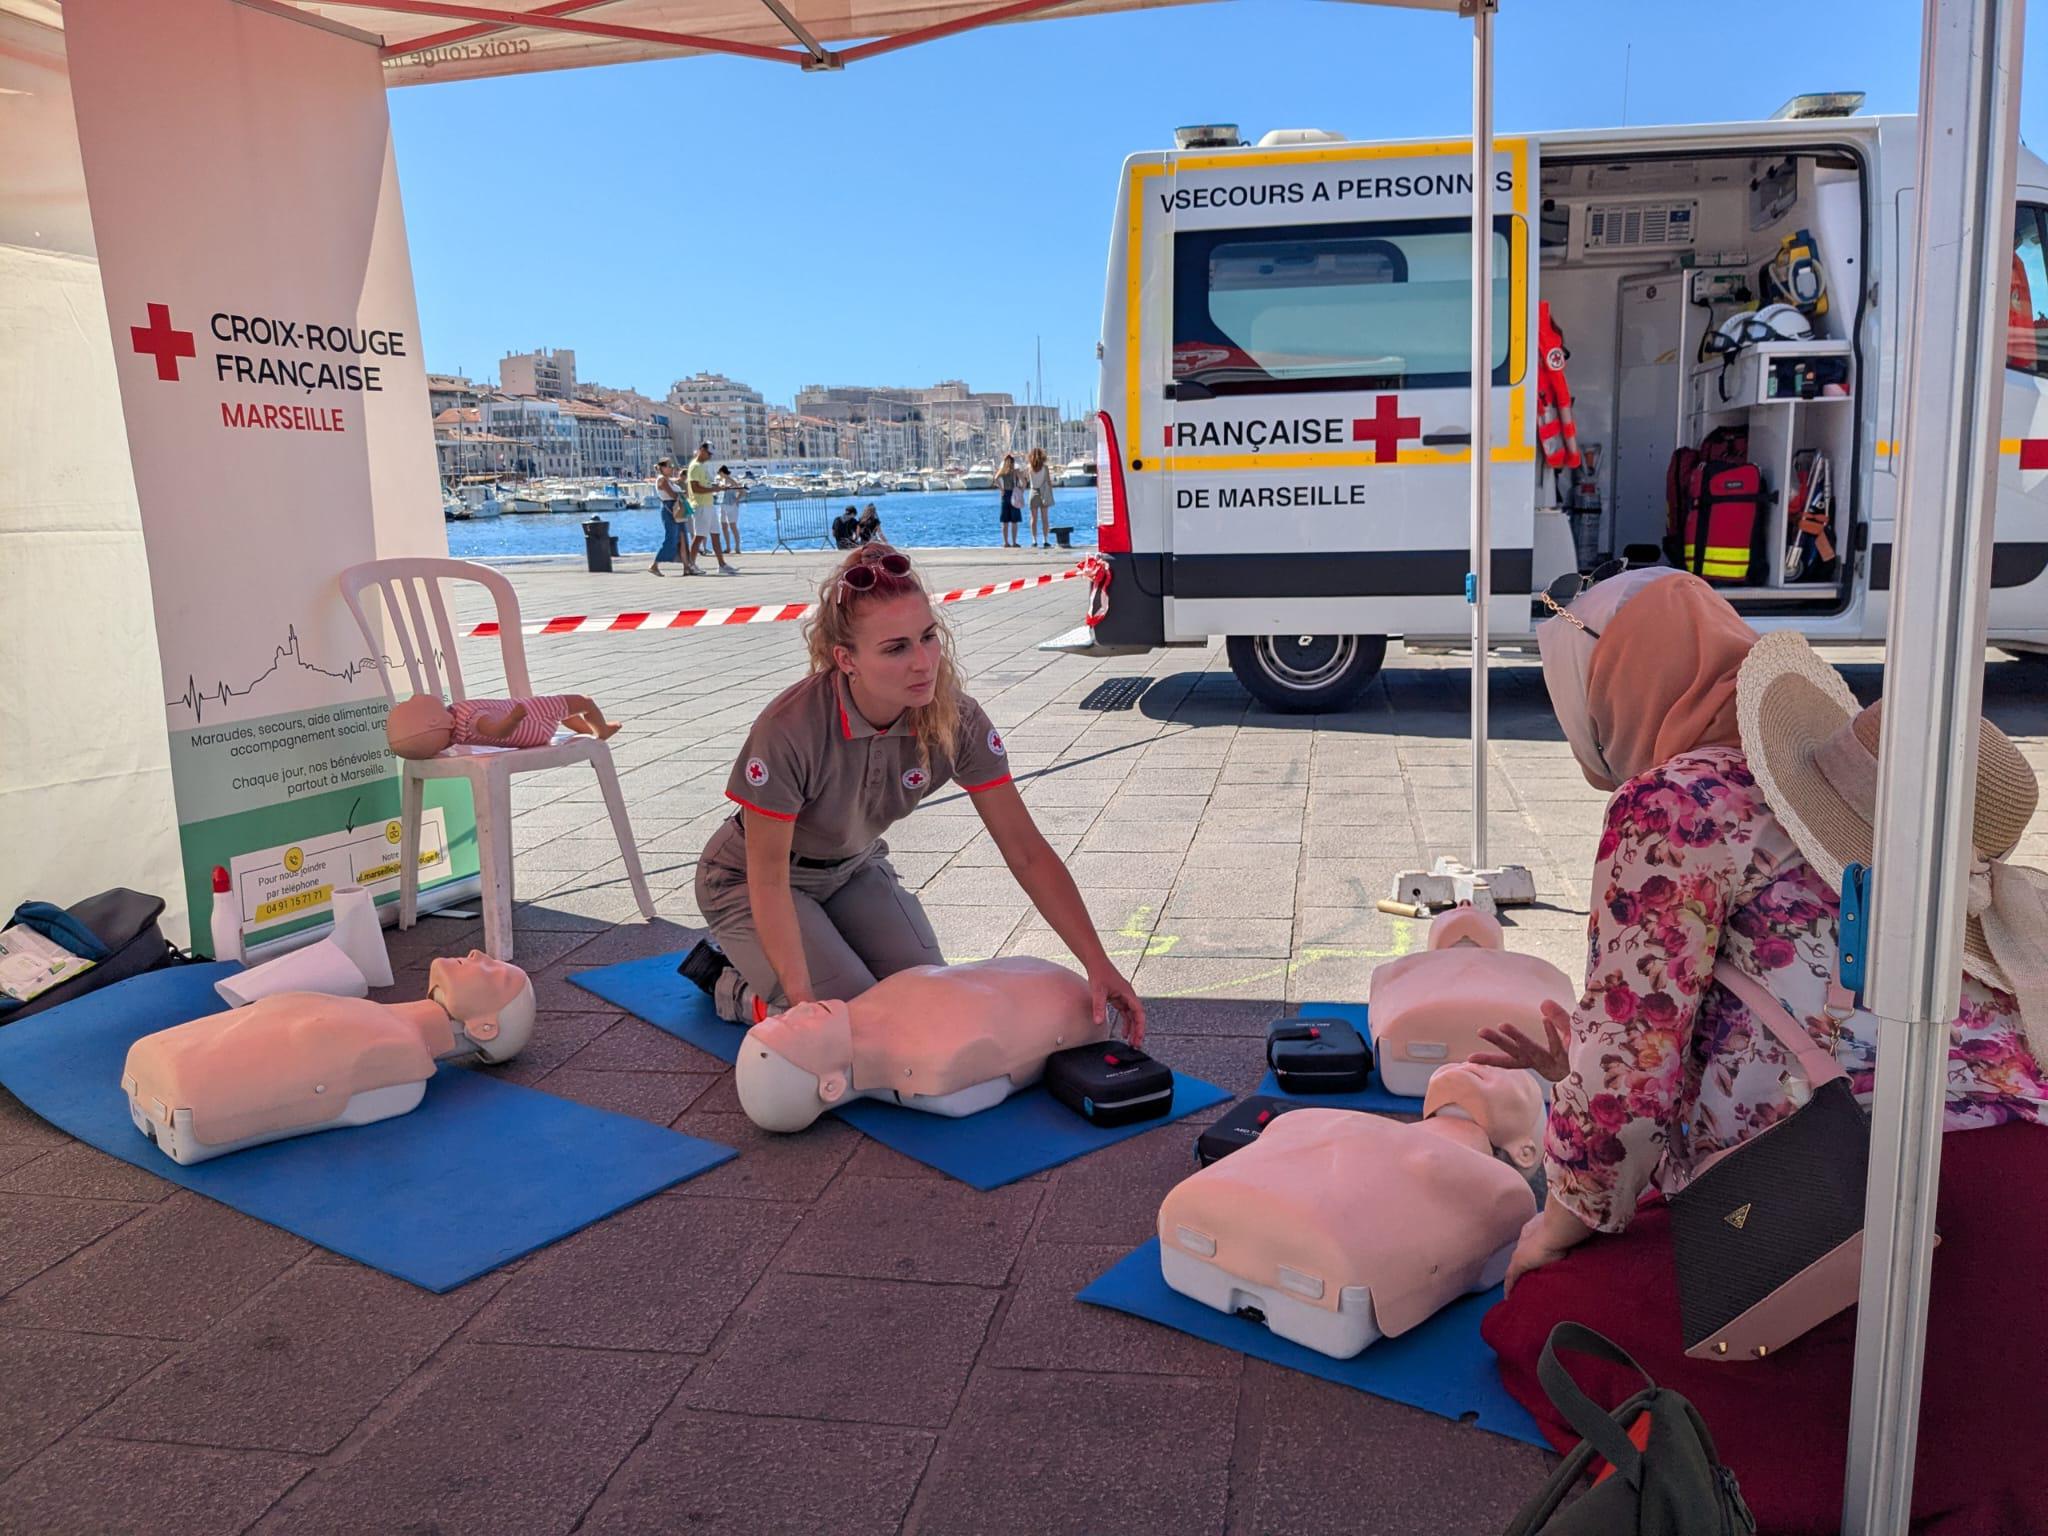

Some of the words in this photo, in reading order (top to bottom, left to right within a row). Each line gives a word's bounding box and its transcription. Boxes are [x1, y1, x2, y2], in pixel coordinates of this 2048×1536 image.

[1312, 181, 1330, 202] A
[1338, 171, 1514, 202] PERSONNS
[211, 313, 407, 357] CROIX-ROUGE
[215, 353, 384, 394] FRANÇAISE
[221, 402, 345, 432] MARSEILLE
[1172, 418, 1344, 453] RANÇAISE
[1177, 488, 1210, 509] DE
[1218, 484, 1366, 508] MARSEILLE
[191, 727, 256, 748] Maraudes,
[258, 719, 306, 735] secours,
[307, 712, 330, 726] aide
[230, 728, 336, 757] accompagnement
[338, 720, 370, 736] social,
[232, 771, 279, 790] Chaque
[282, 766, 307, 782] jour,
[309, 761, 328, 773] nos
[330, 750, 382, 769] bénévoles
[287, 775, 329, 797] partout
[331, 773, 338, 784] à
[258, 875, 277, 886] Pour
[266, 889, 280, 901] par
[266, 903, 277, 914] 04
